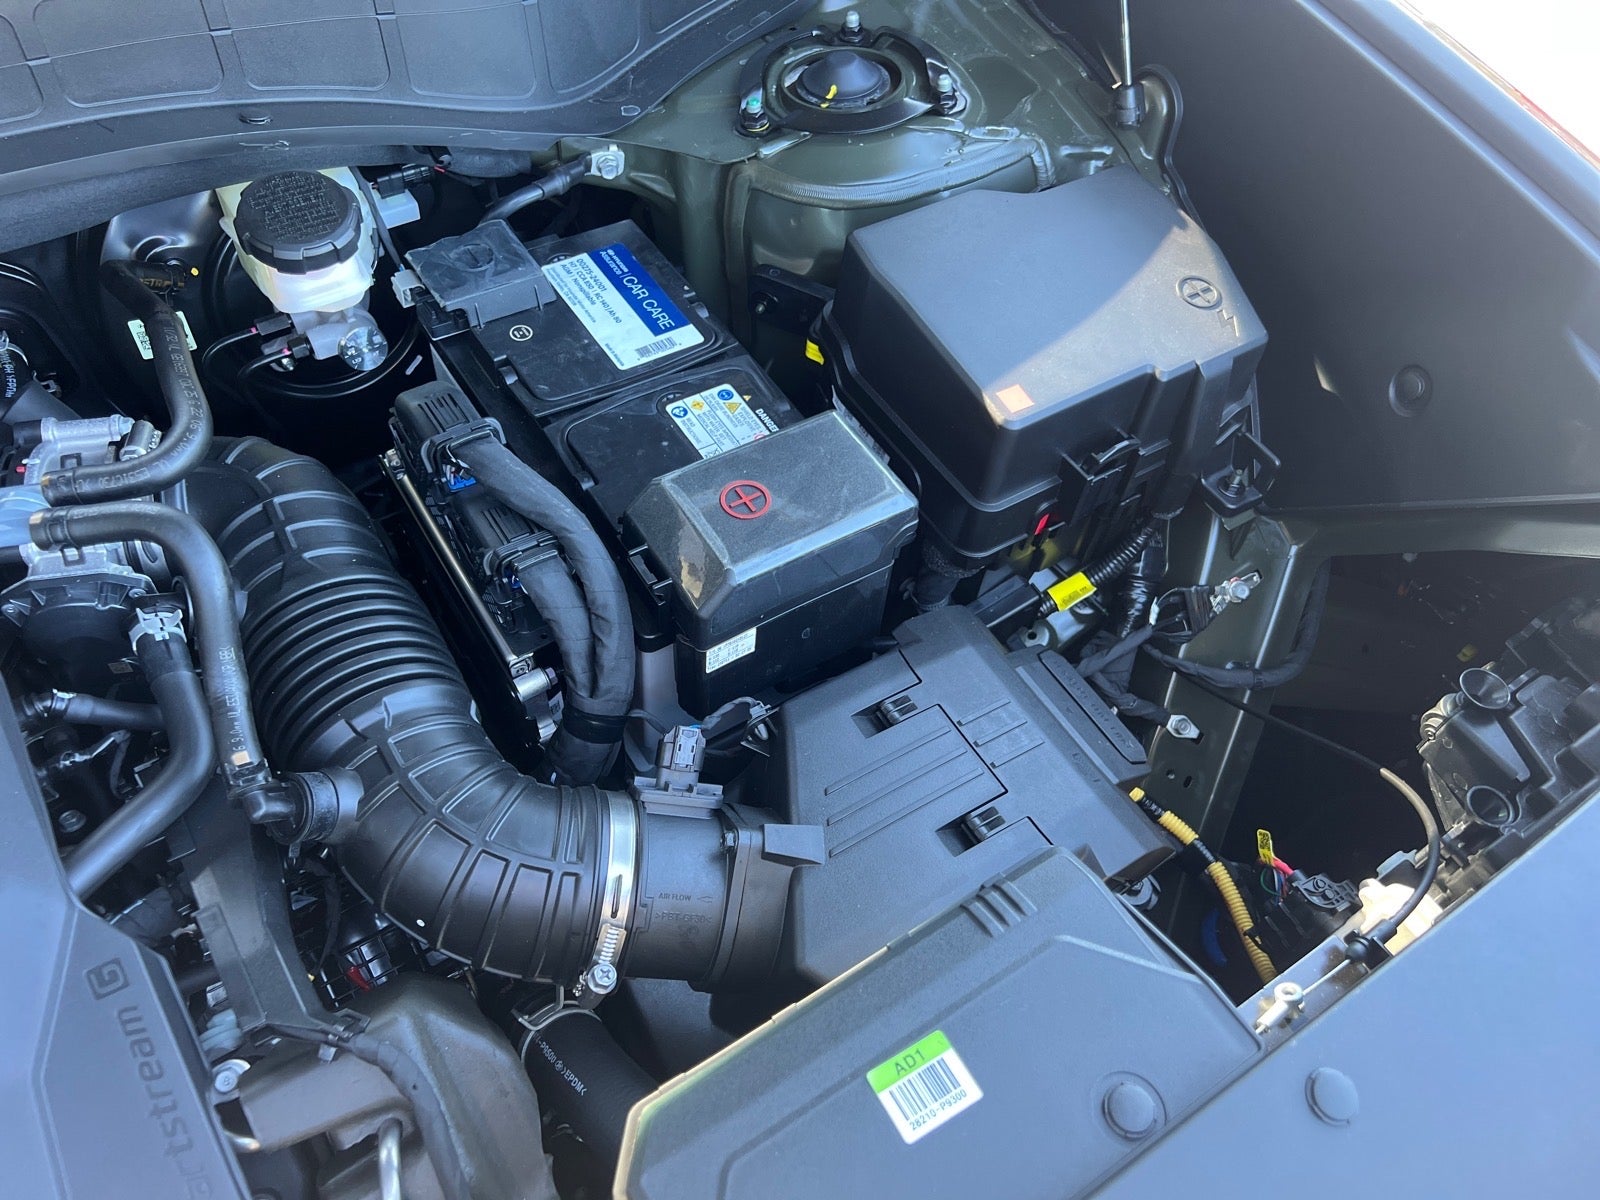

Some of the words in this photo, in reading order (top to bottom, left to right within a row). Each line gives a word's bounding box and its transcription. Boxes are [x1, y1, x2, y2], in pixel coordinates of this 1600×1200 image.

[575, 257, 607, 292] 00275-24001
[599, 250, 622, 275] Assurance
[621, 274, 649, 300] CAR
[641, 297, 675, 330] CARE
[658, 892, 671, 900] AIR
[671, 893, 692, 902] FLOW
[893, 1047, 926, 1075] AD1
[909, 1088, 967, 1130] 28210-P9300
